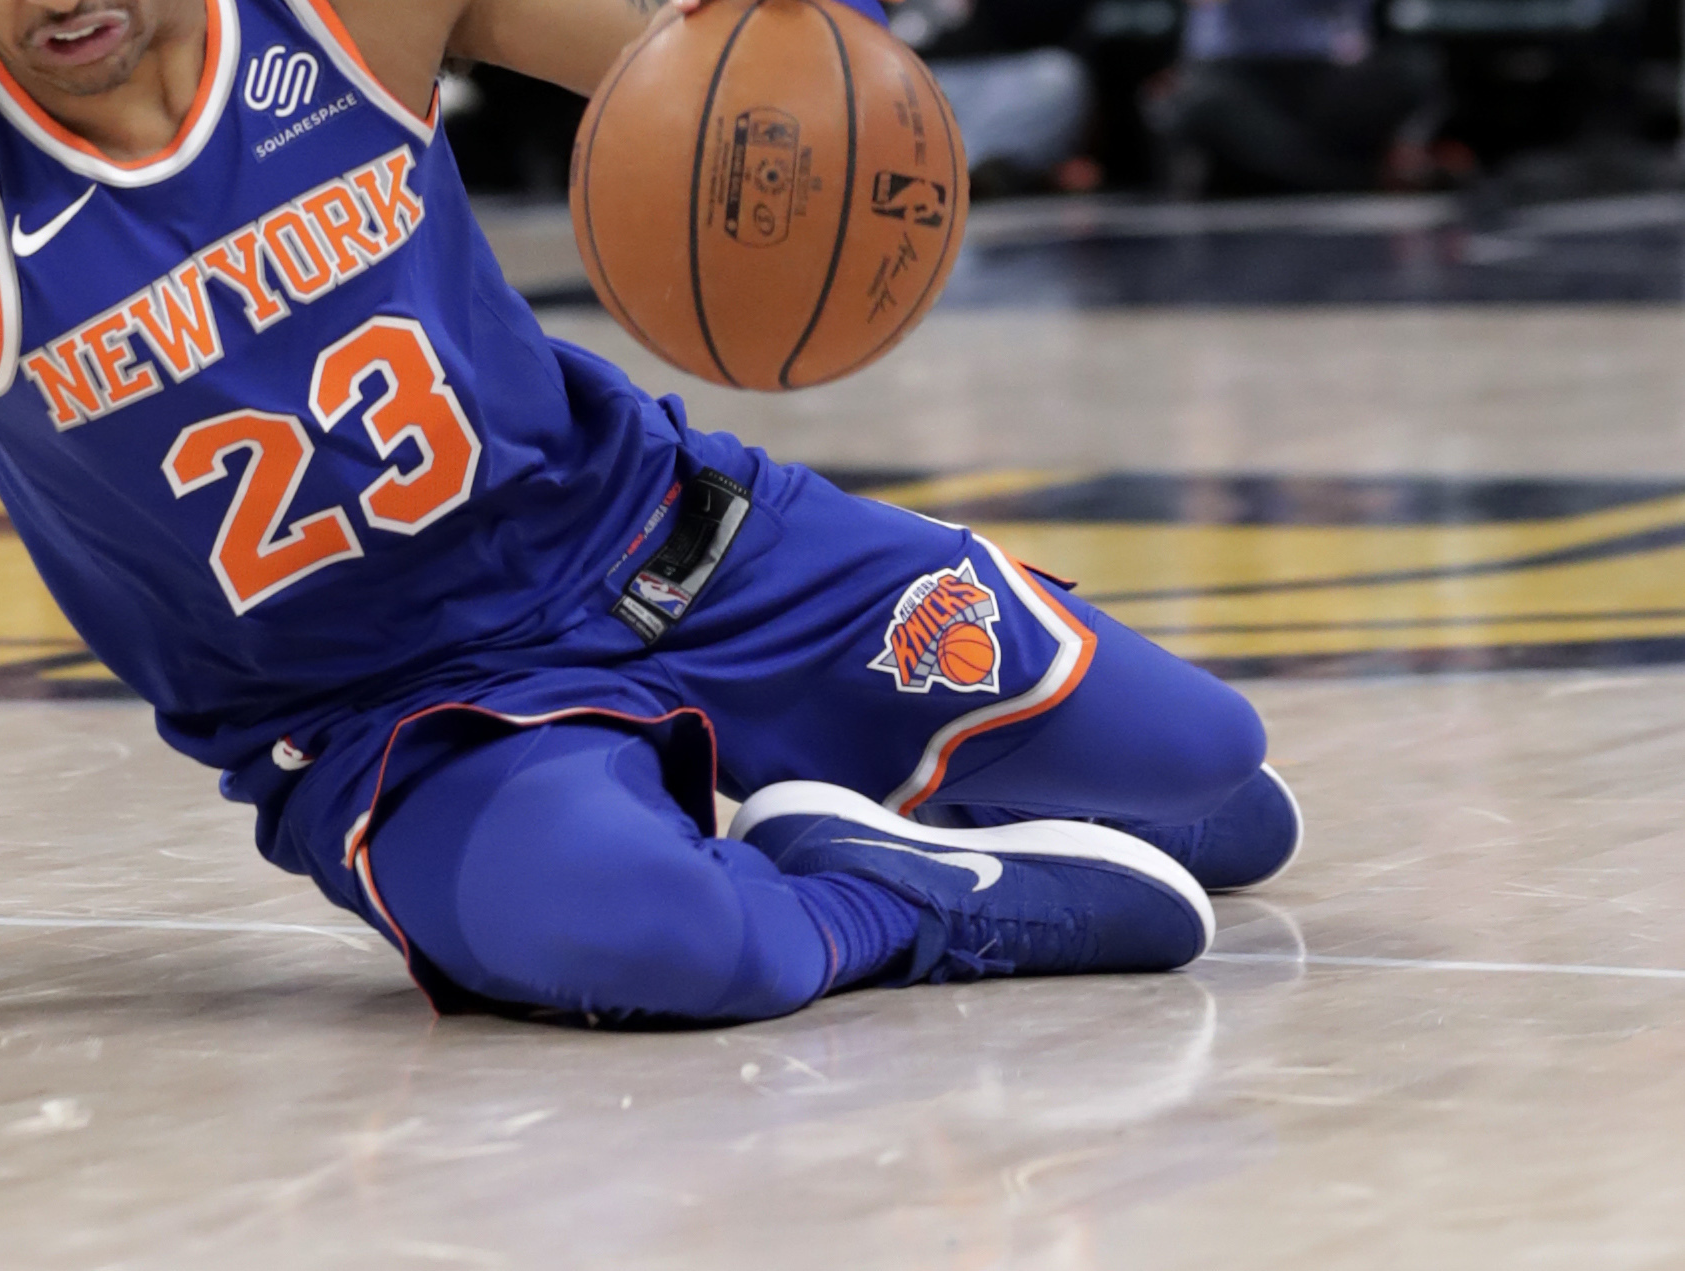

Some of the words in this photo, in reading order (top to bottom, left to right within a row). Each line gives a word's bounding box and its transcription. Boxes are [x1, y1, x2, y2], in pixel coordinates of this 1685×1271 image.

[255, 93, 358, 158] SQUARESPACE
[18, 254, 225, 433] NEW
[202, 144, 426, 334] YORK
[161, 316, 482, 616] 23
[891, 574, 990, 685] KNICKS
